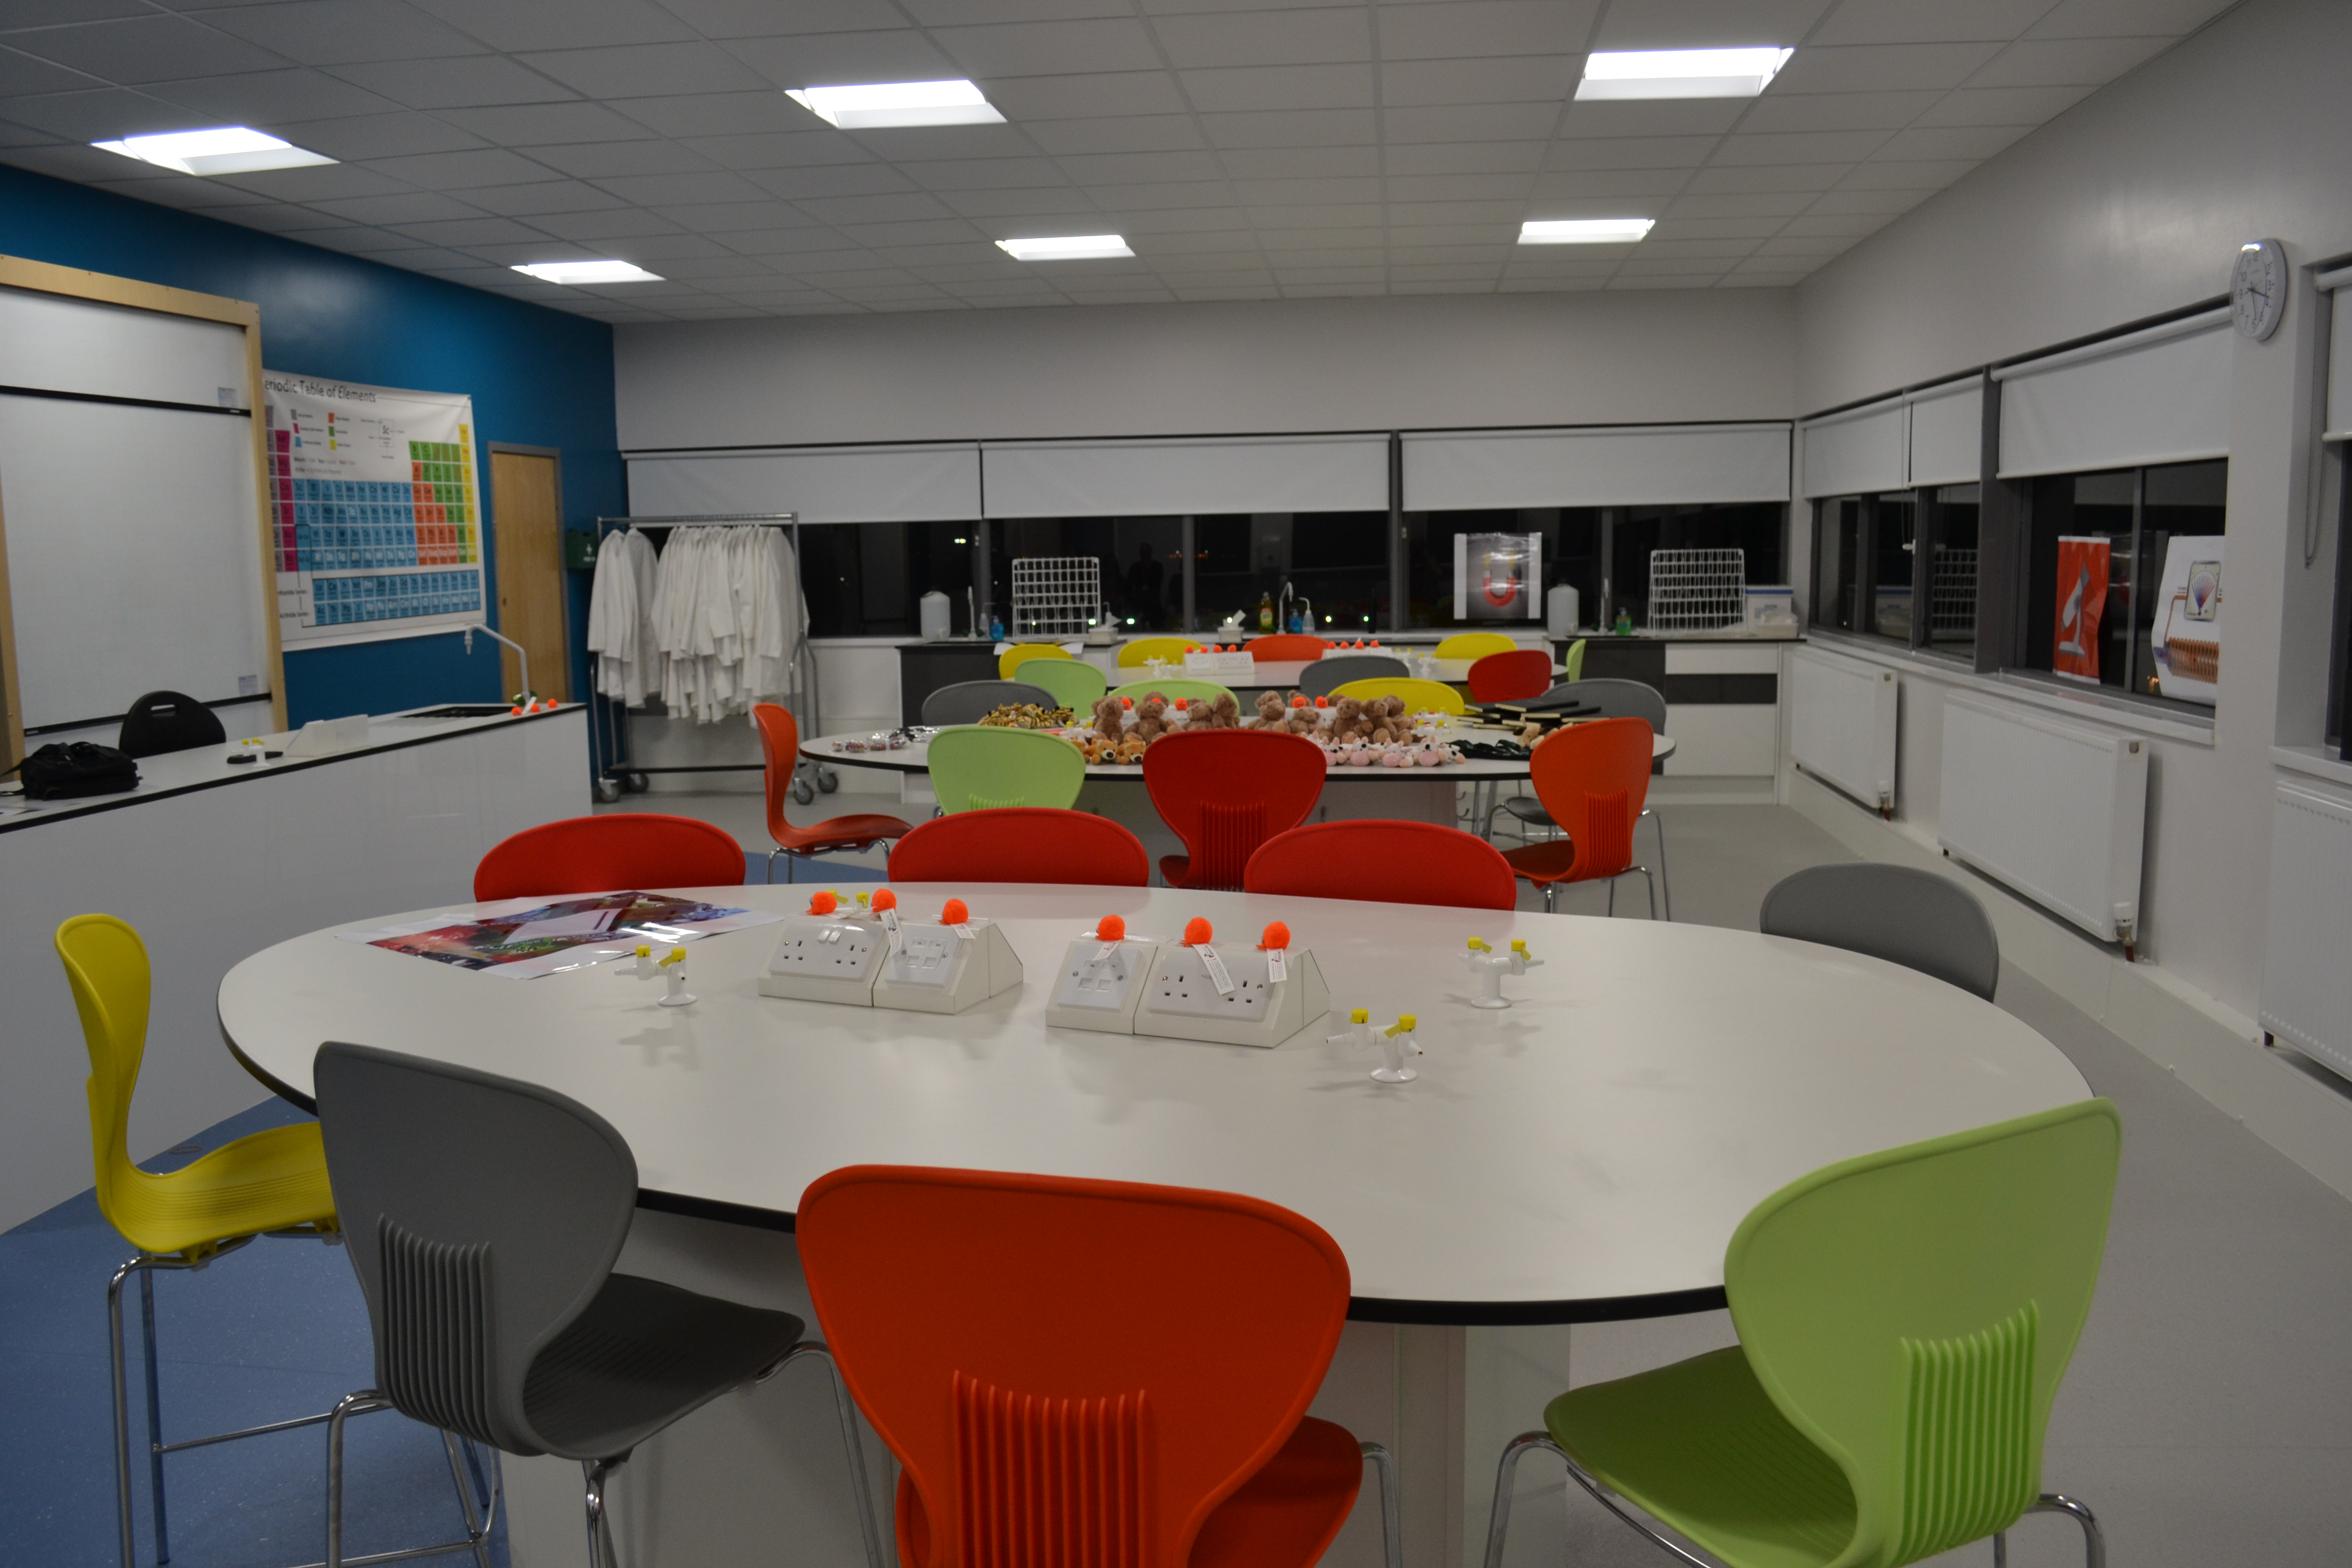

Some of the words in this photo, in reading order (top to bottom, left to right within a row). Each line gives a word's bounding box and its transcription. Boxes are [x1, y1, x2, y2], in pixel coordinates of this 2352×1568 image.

[2239, 288, 2243, 300] 9
[264, 379, 298, 394] eriodic
[299, 380, 324, 397] Table
[326, 385, 337, 399] of
[337, 385, 377, 403] Elements
